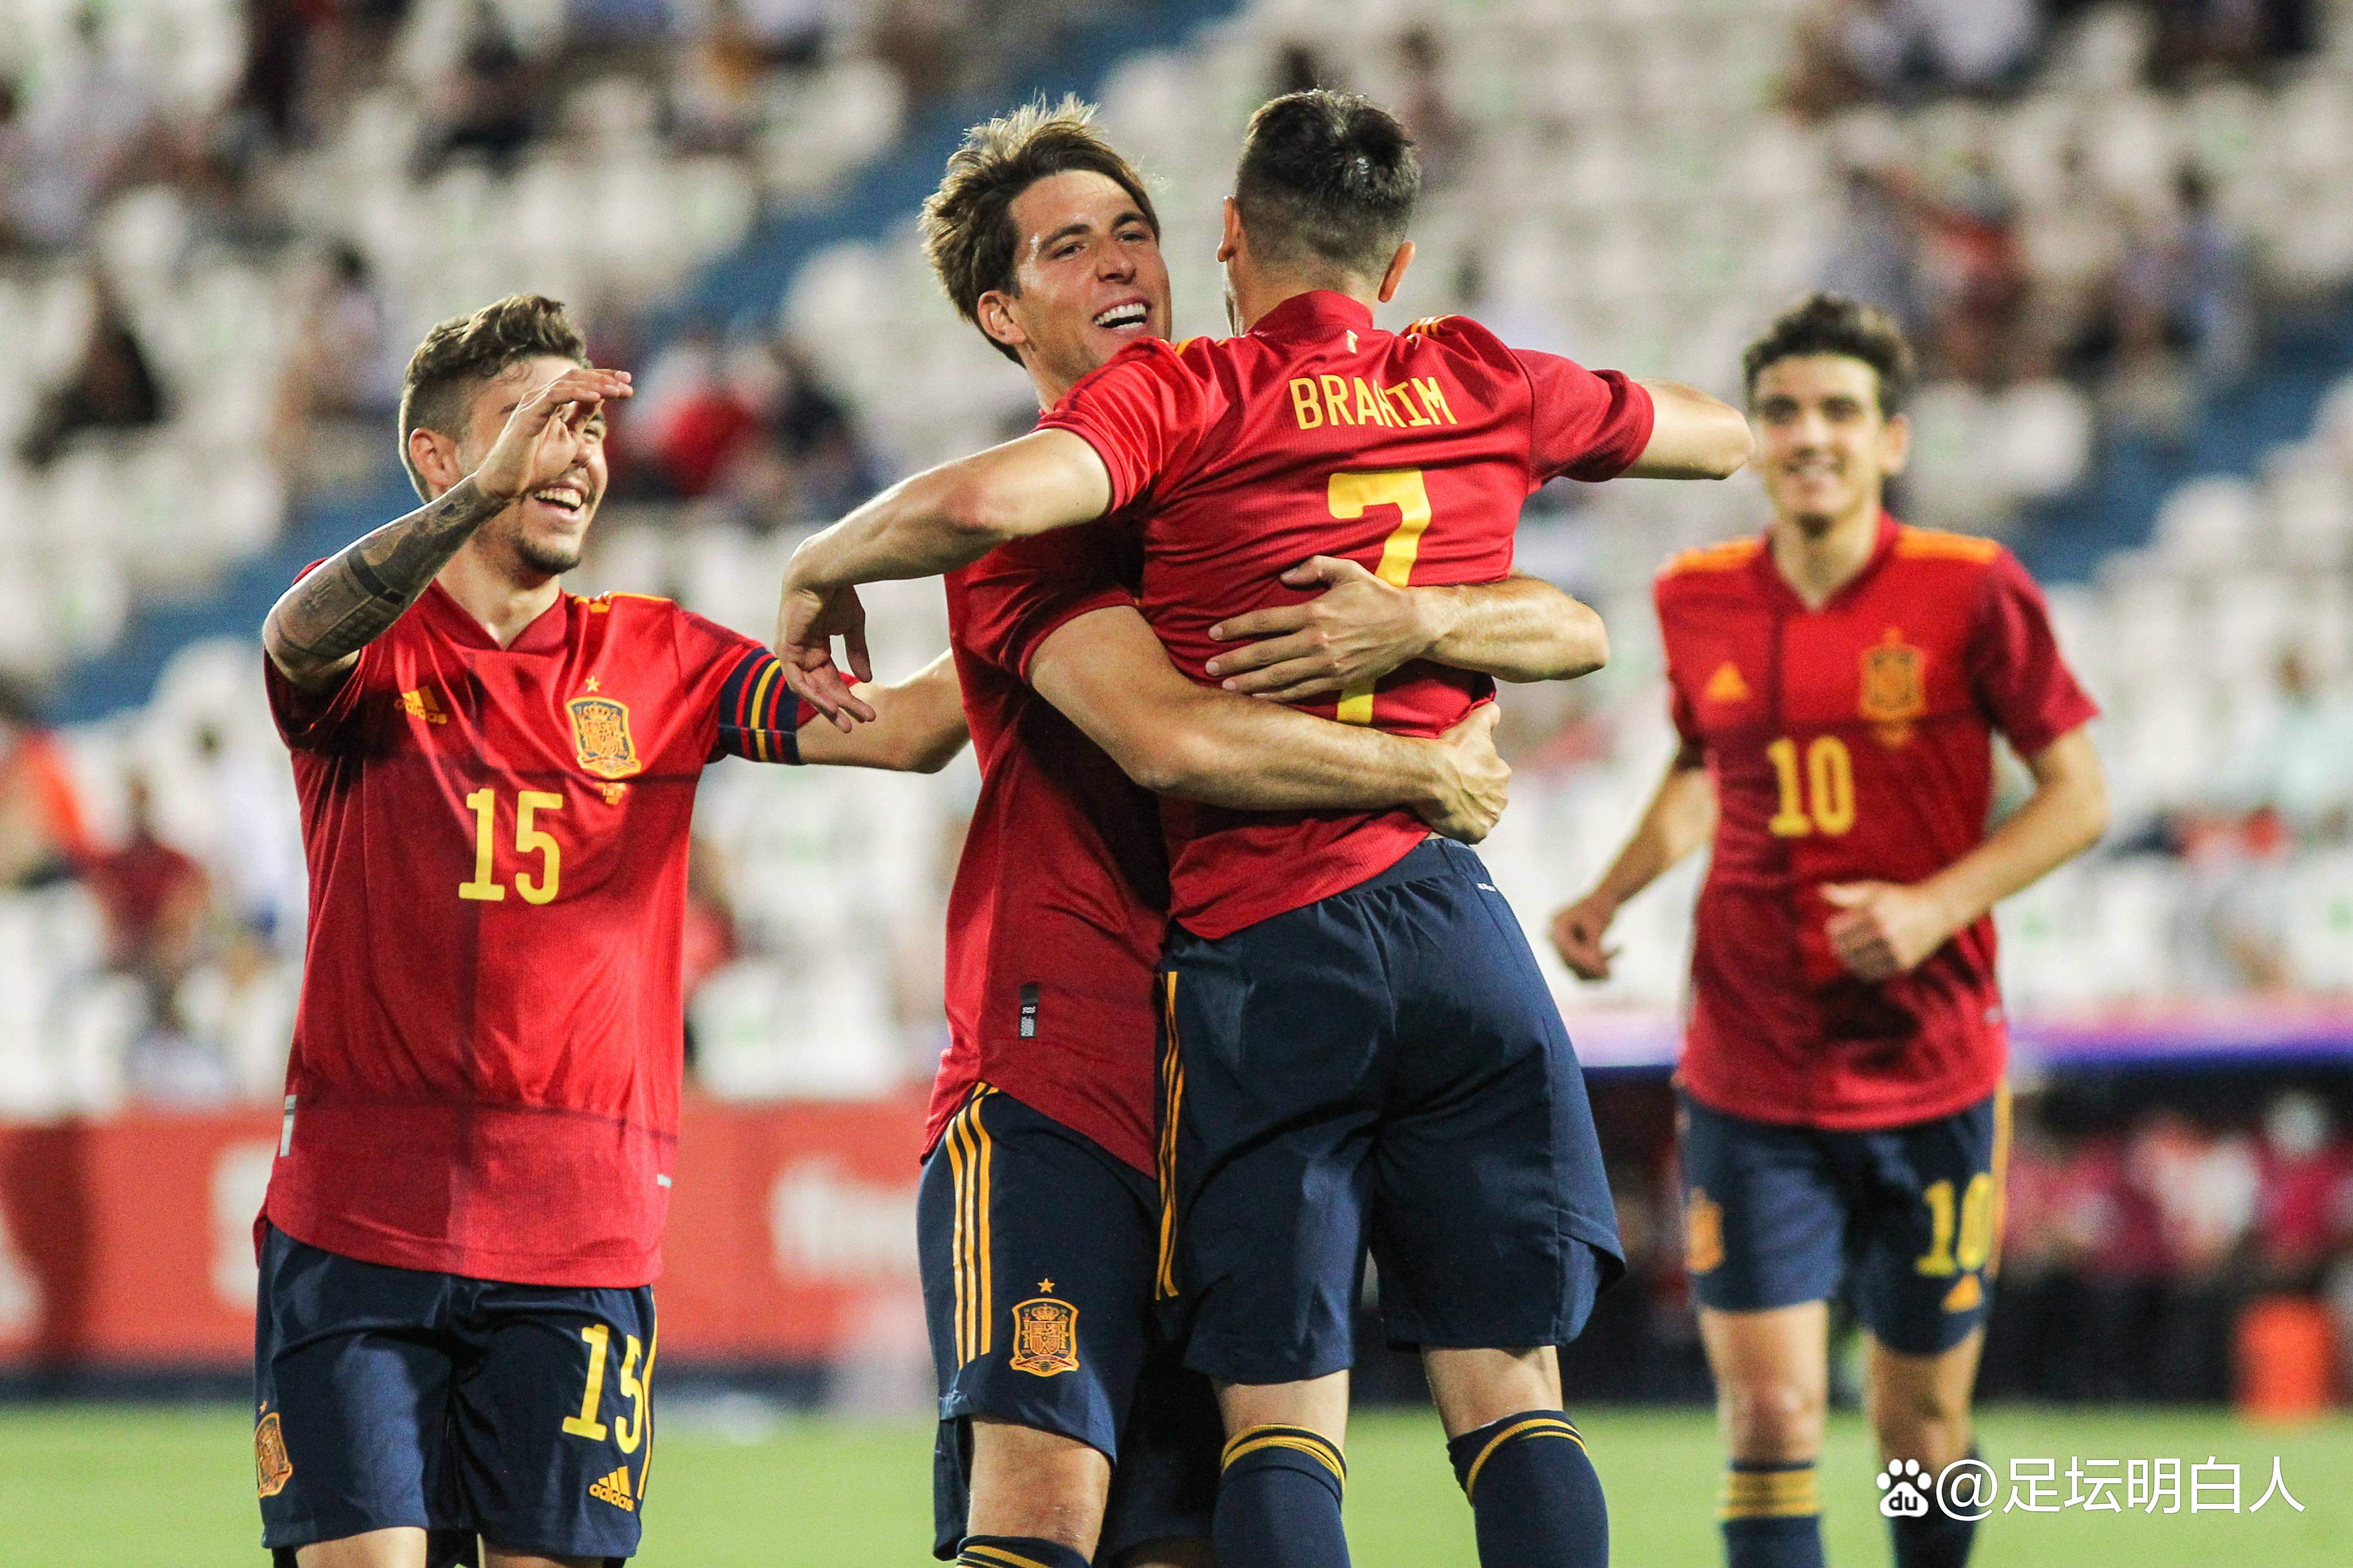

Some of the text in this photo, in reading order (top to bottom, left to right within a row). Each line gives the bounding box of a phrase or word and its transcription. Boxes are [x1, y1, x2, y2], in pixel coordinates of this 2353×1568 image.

[1328, 467, 1432, 724] 7
[394, 698, 447, 724] adidas
[1766, 736, 1856, 836] 10
[458, 788, 563, 905] 15
[1915, 1173, 1993, 1277] 10
[562, 1323, 644, 1453] 15
[589, 1484, 634, 1512] adidas
